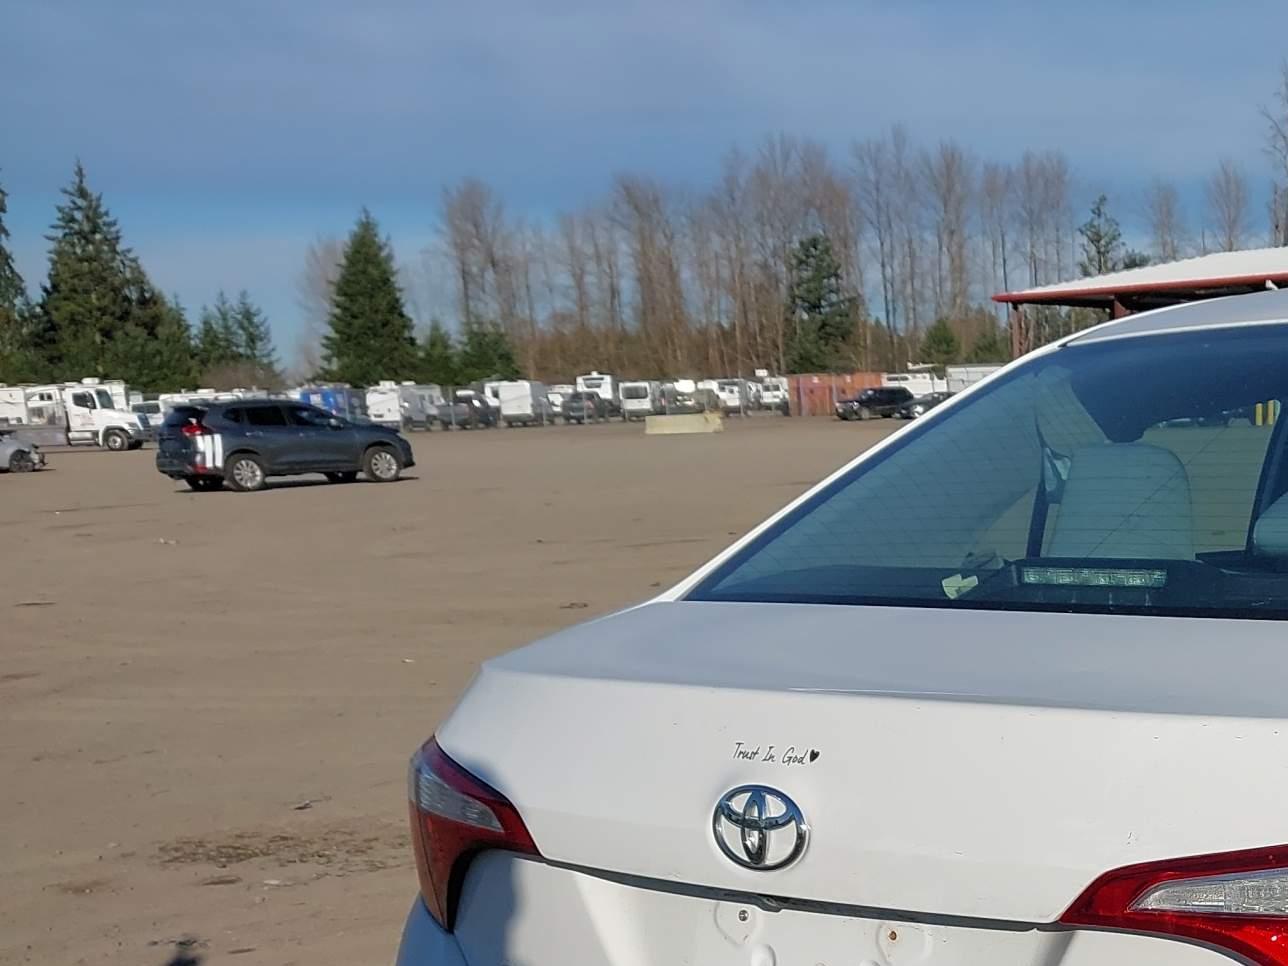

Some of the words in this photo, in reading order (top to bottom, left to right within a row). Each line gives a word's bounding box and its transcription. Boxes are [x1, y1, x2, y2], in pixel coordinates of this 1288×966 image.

[733, 742, 760, 760] Trust
[761, 746, 776, 762] In
[782, 746, 808, 766] God
